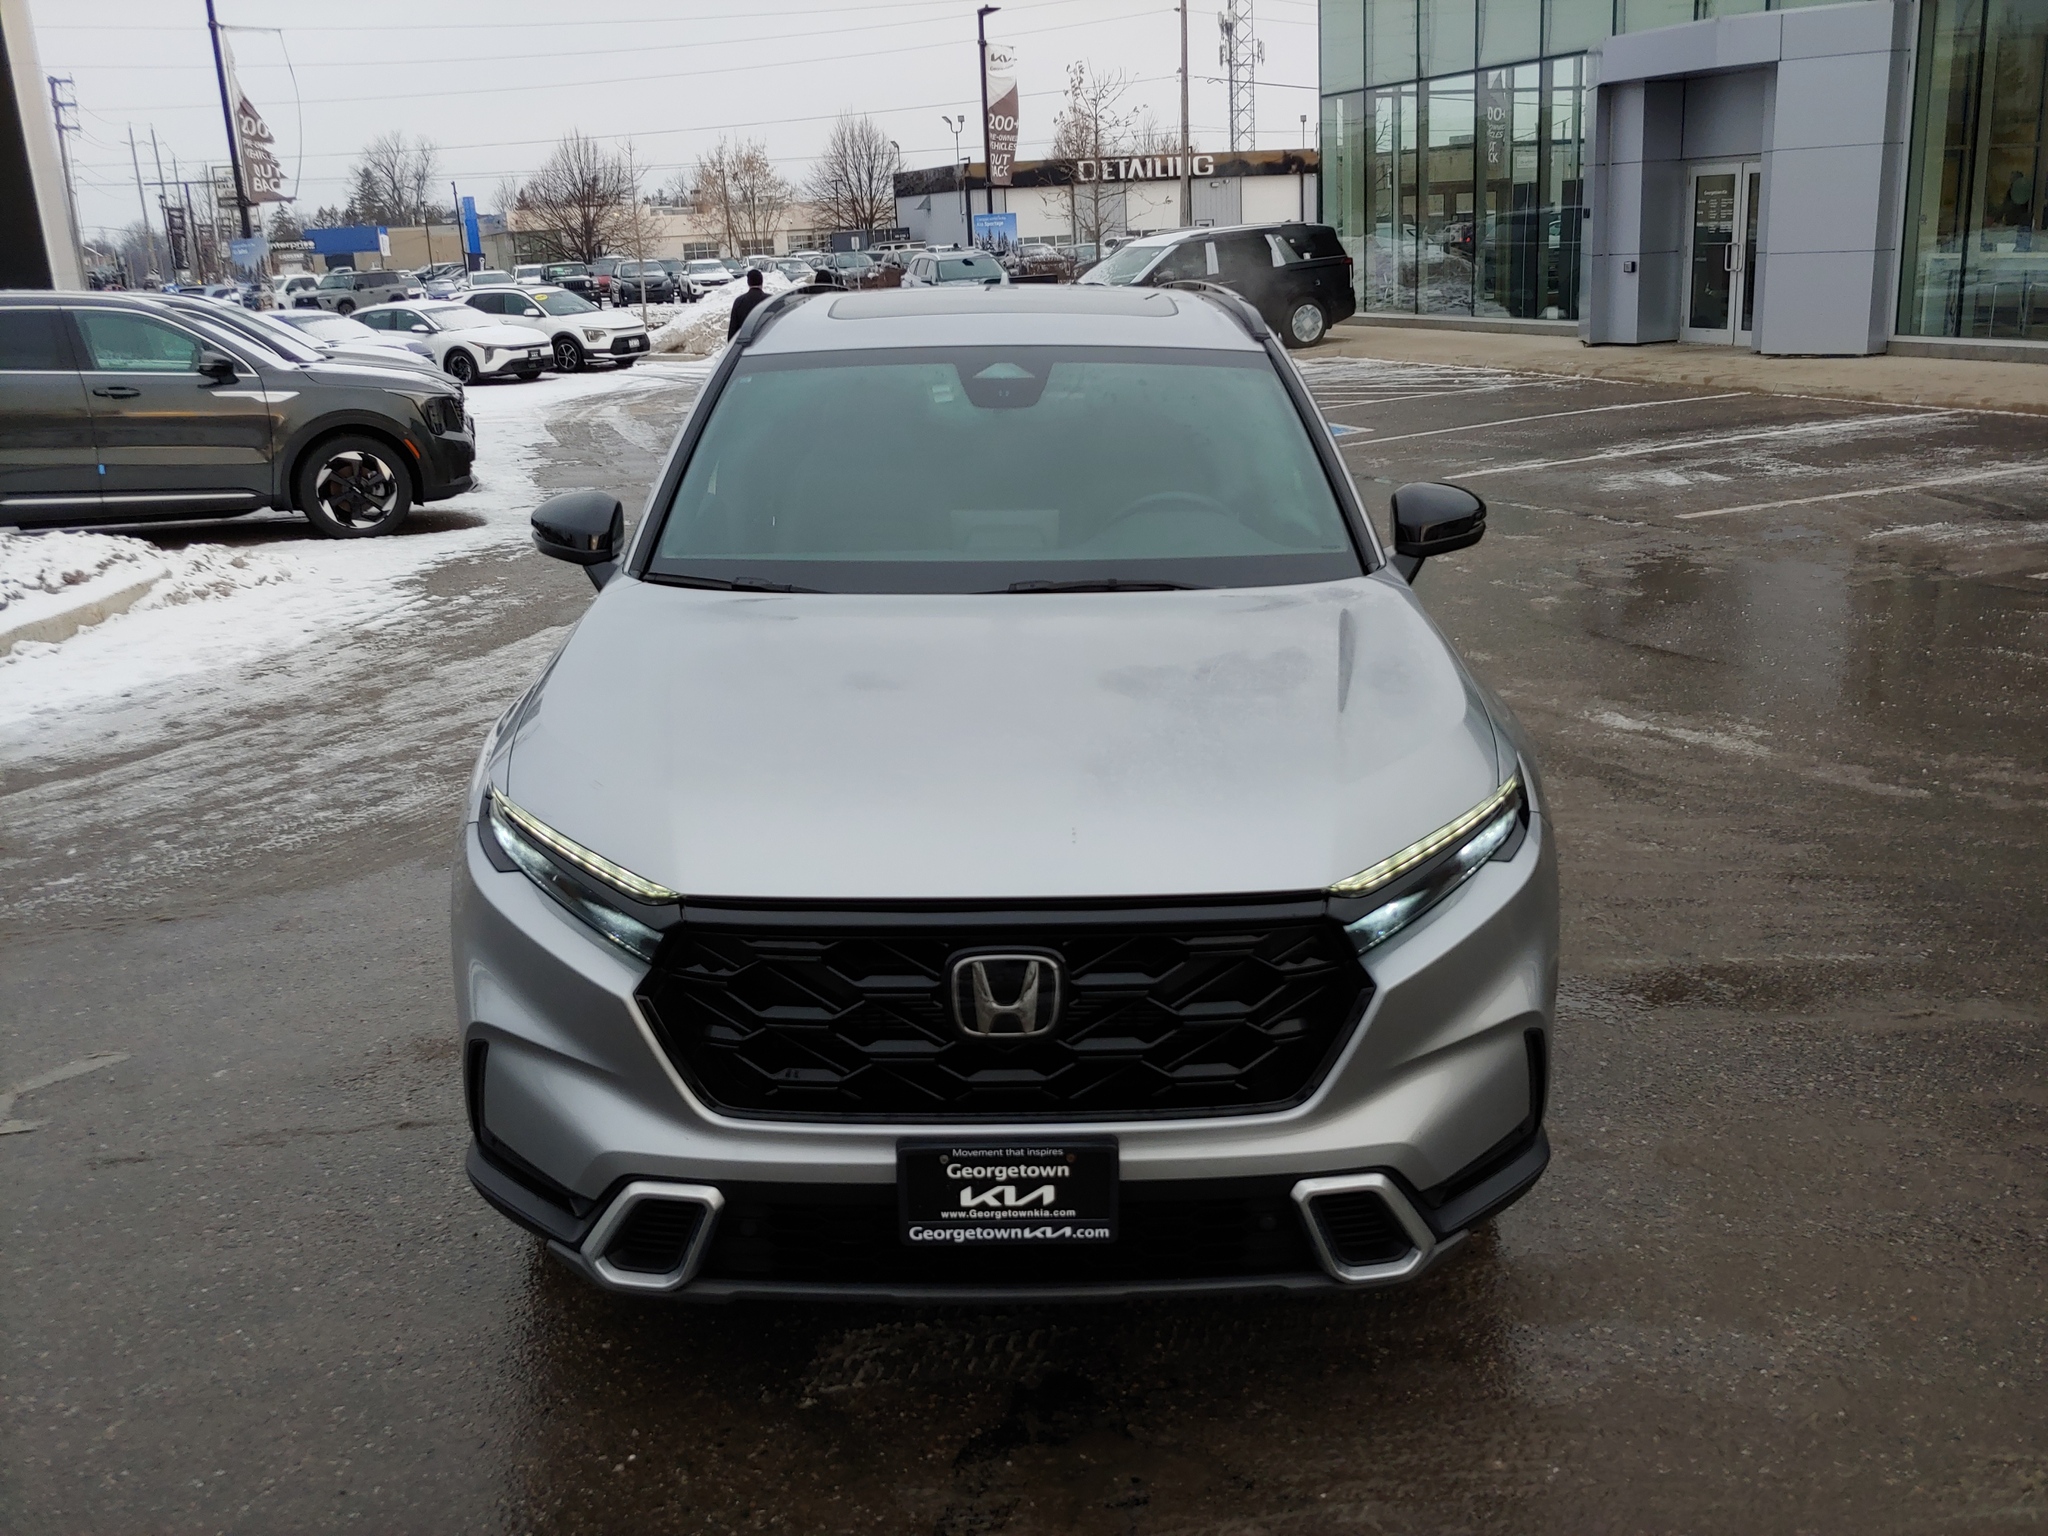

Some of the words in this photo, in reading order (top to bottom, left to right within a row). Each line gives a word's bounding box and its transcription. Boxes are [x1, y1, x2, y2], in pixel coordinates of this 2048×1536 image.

[988, 113, 1019, 131] 200+
[253, 177, 282, 193] BAC
[269, 240, 315, 250] nterprise
[952, 1148, 1003, 1157] Movement
[1005, 1148, 1024, 1157] that
[1026, 1148, 1063, 1158] inspires
[946, 1163, 1070, 1181] Georgetown
[960, 1184, 1055, 1207] KIA
[941, 1208, 1076, 1219] www.Georgetownkia.com
